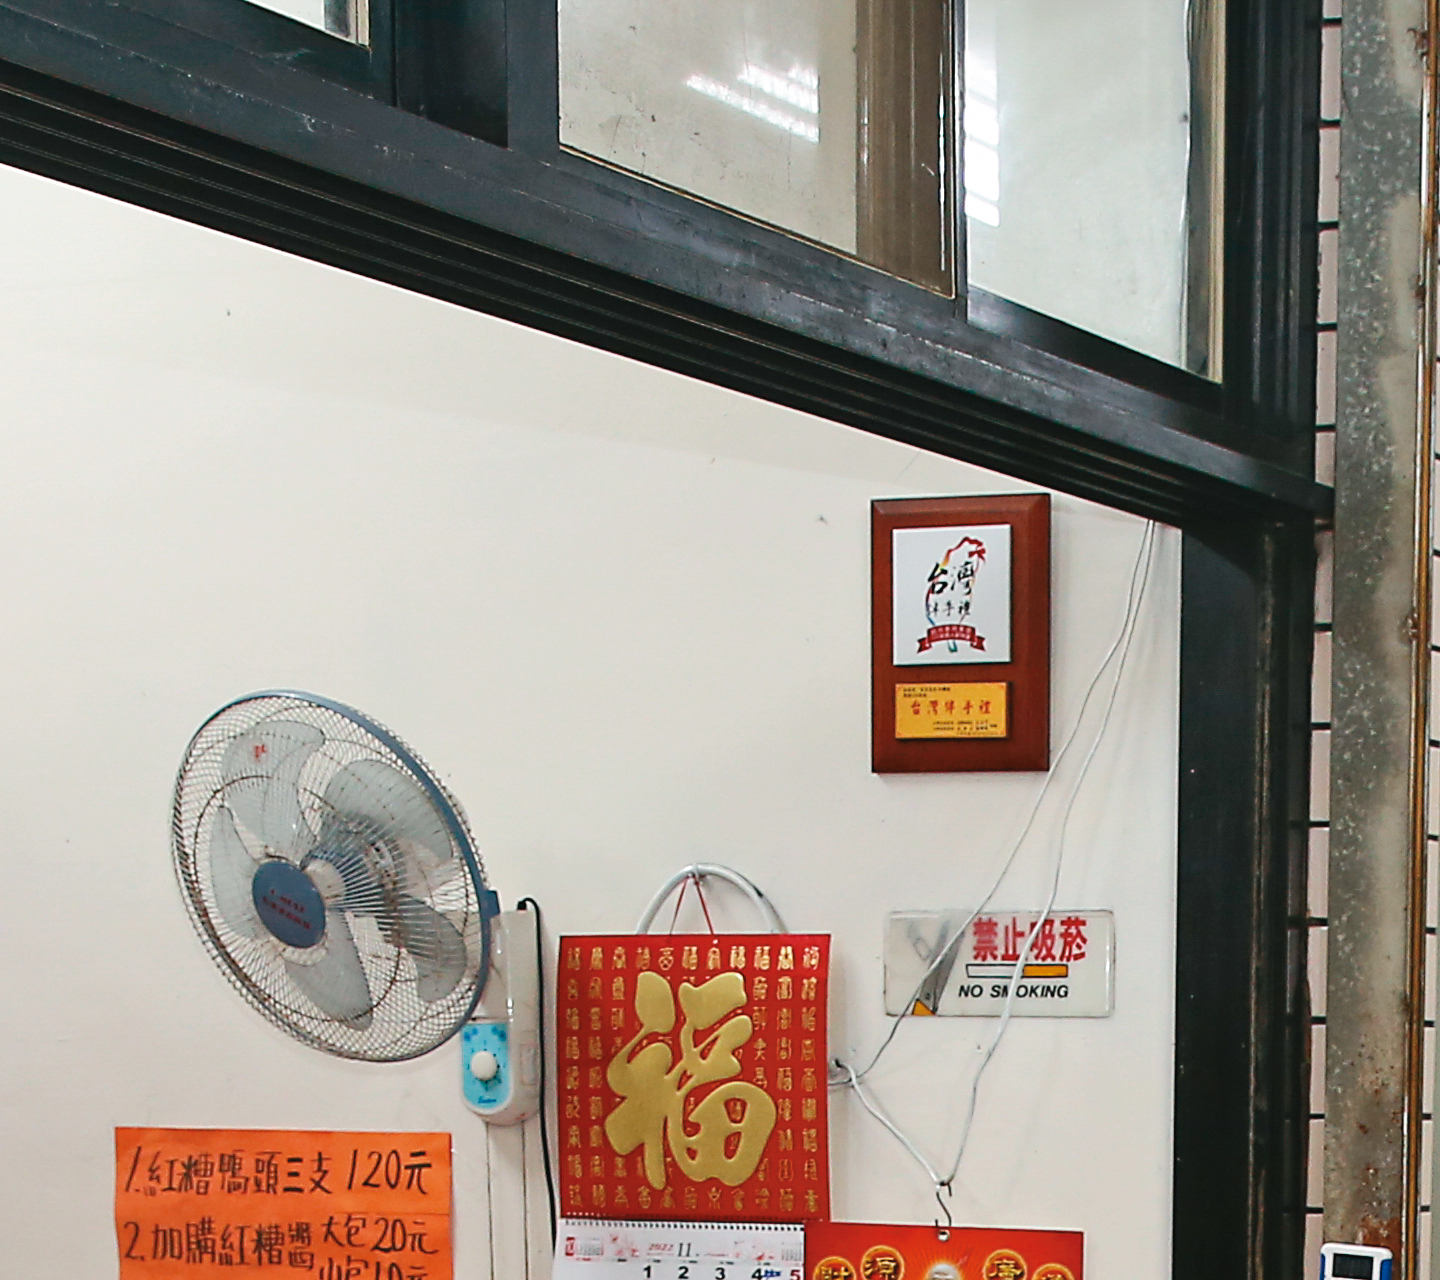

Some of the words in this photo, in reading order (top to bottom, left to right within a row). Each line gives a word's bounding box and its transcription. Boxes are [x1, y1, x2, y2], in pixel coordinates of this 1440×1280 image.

[927, 561, 974, 595] 台灣
[973, 916, 1088, 962] 禁止吸菸
[958, 985, 983, 998] NO
[603, 971, 779, 1190] 福
[348, 1149, 432, 1195] 120元
[678, 1242, 692, 1258] 11
[644, 1266, 651, 1279] 1
[678, 1266, 689, 1280] 2
[715, 1268, 726, 1280] 3
[752, 1269, 762, 1280] 4
